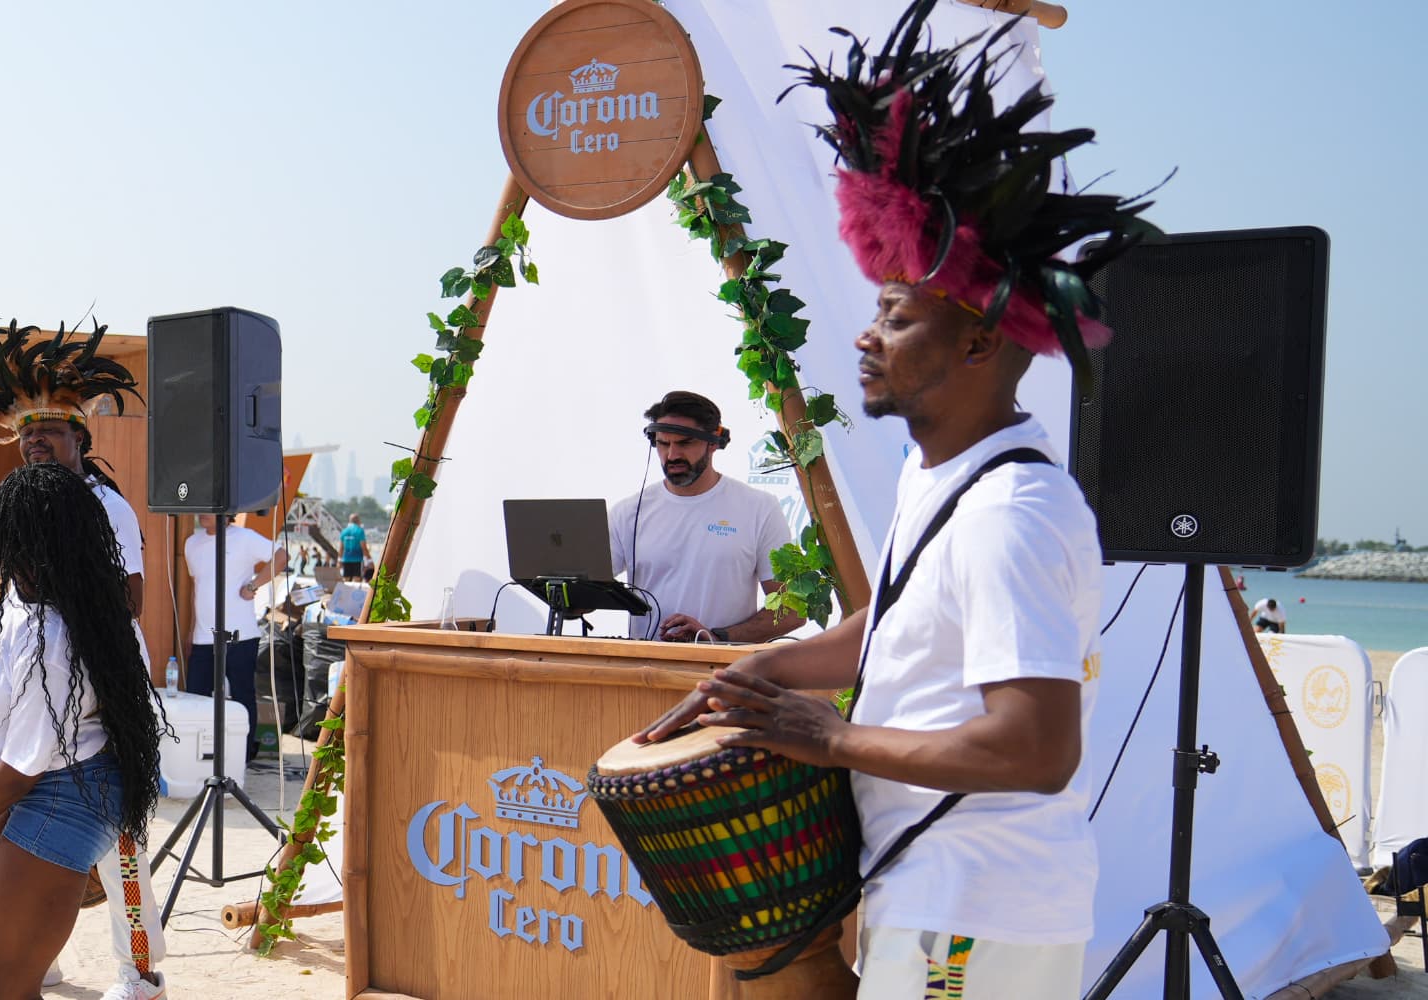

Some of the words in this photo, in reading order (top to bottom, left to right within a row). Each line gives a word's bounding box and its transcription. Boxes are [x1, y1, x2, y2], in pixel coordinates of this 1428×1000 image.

[526, 90, 661, 140] Corona
[570, 129, 620, 154] Cero
[488, 888, 584, 951] Cero
